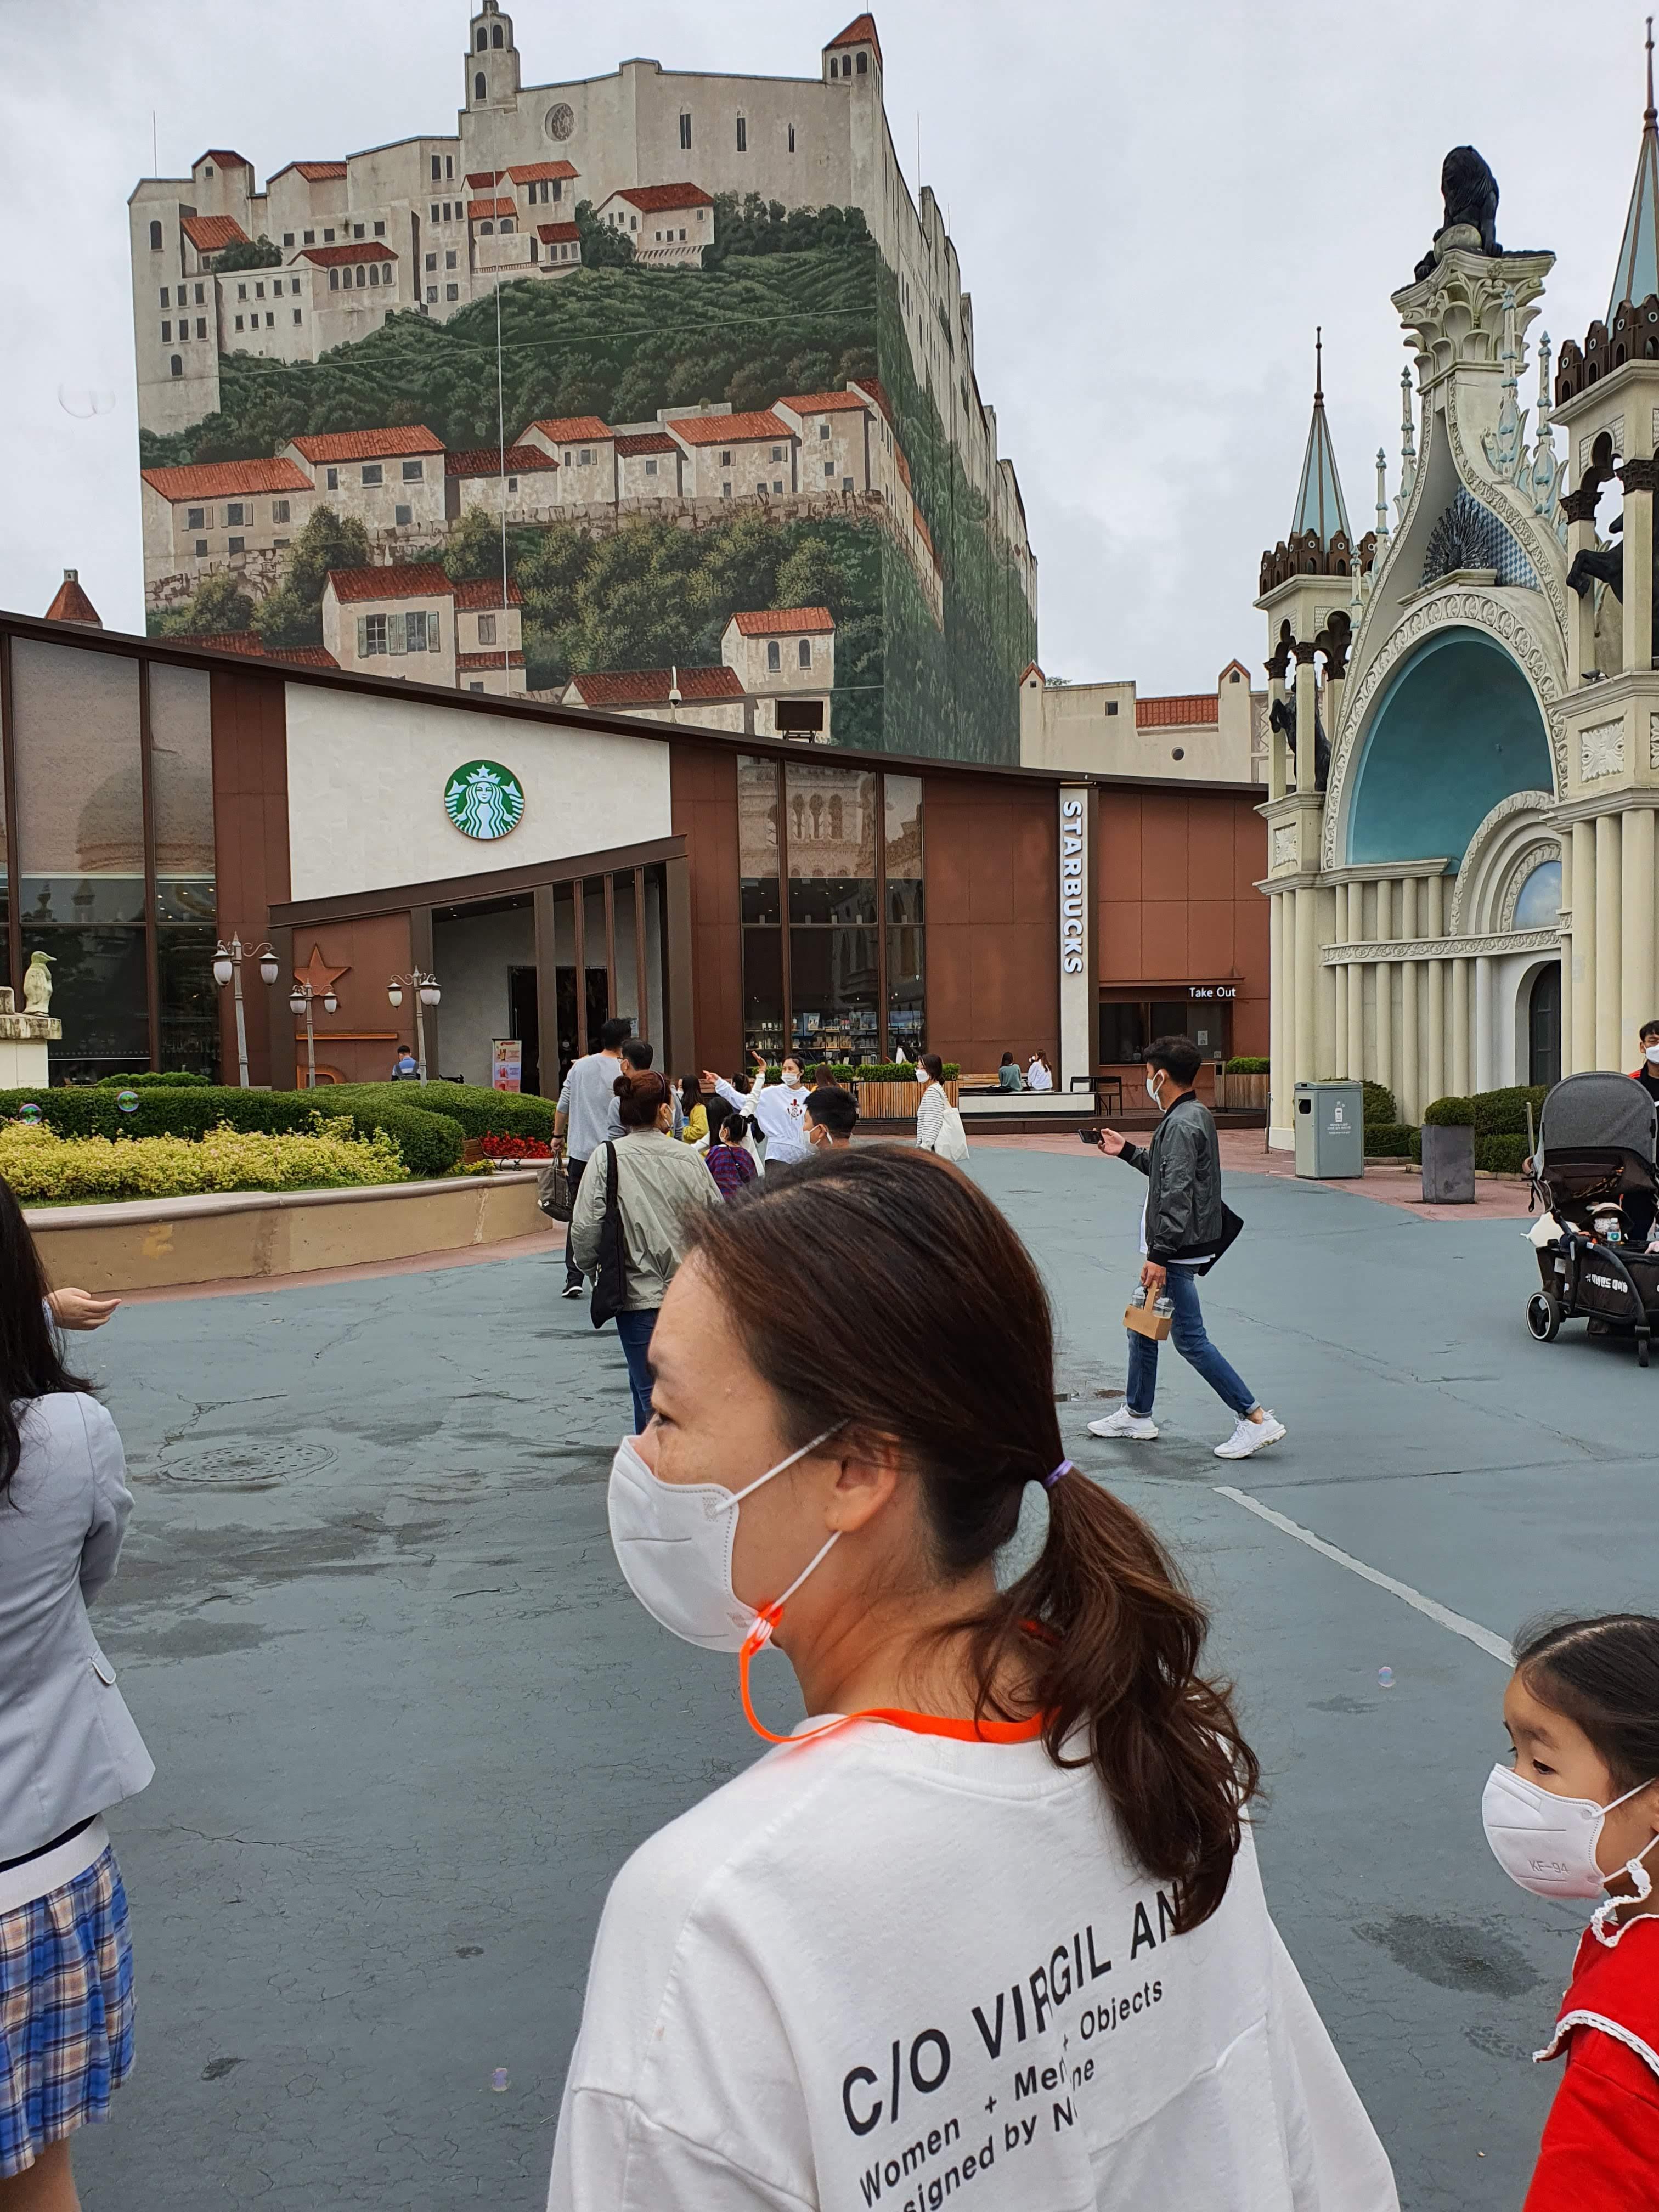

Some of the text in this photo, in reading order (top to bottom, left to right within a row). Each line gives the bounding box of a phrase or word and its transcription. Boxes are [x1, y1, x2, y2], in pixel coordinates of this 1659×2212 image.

[1063, 800, 1084, 974] STARBUCKS
[1189, 987, 1237, 998] Take Out
[1528, 1860, 1569, 1874] KF-94
[842, 2028, 951, 2136] C/O
[971, 1925, 1112, 2061] VIRGIL
[859, 2118, 961, 2208] Women
[1080, 1979, 1163, 2041] Objects
[1005, 2115, 1037, 2152] by
